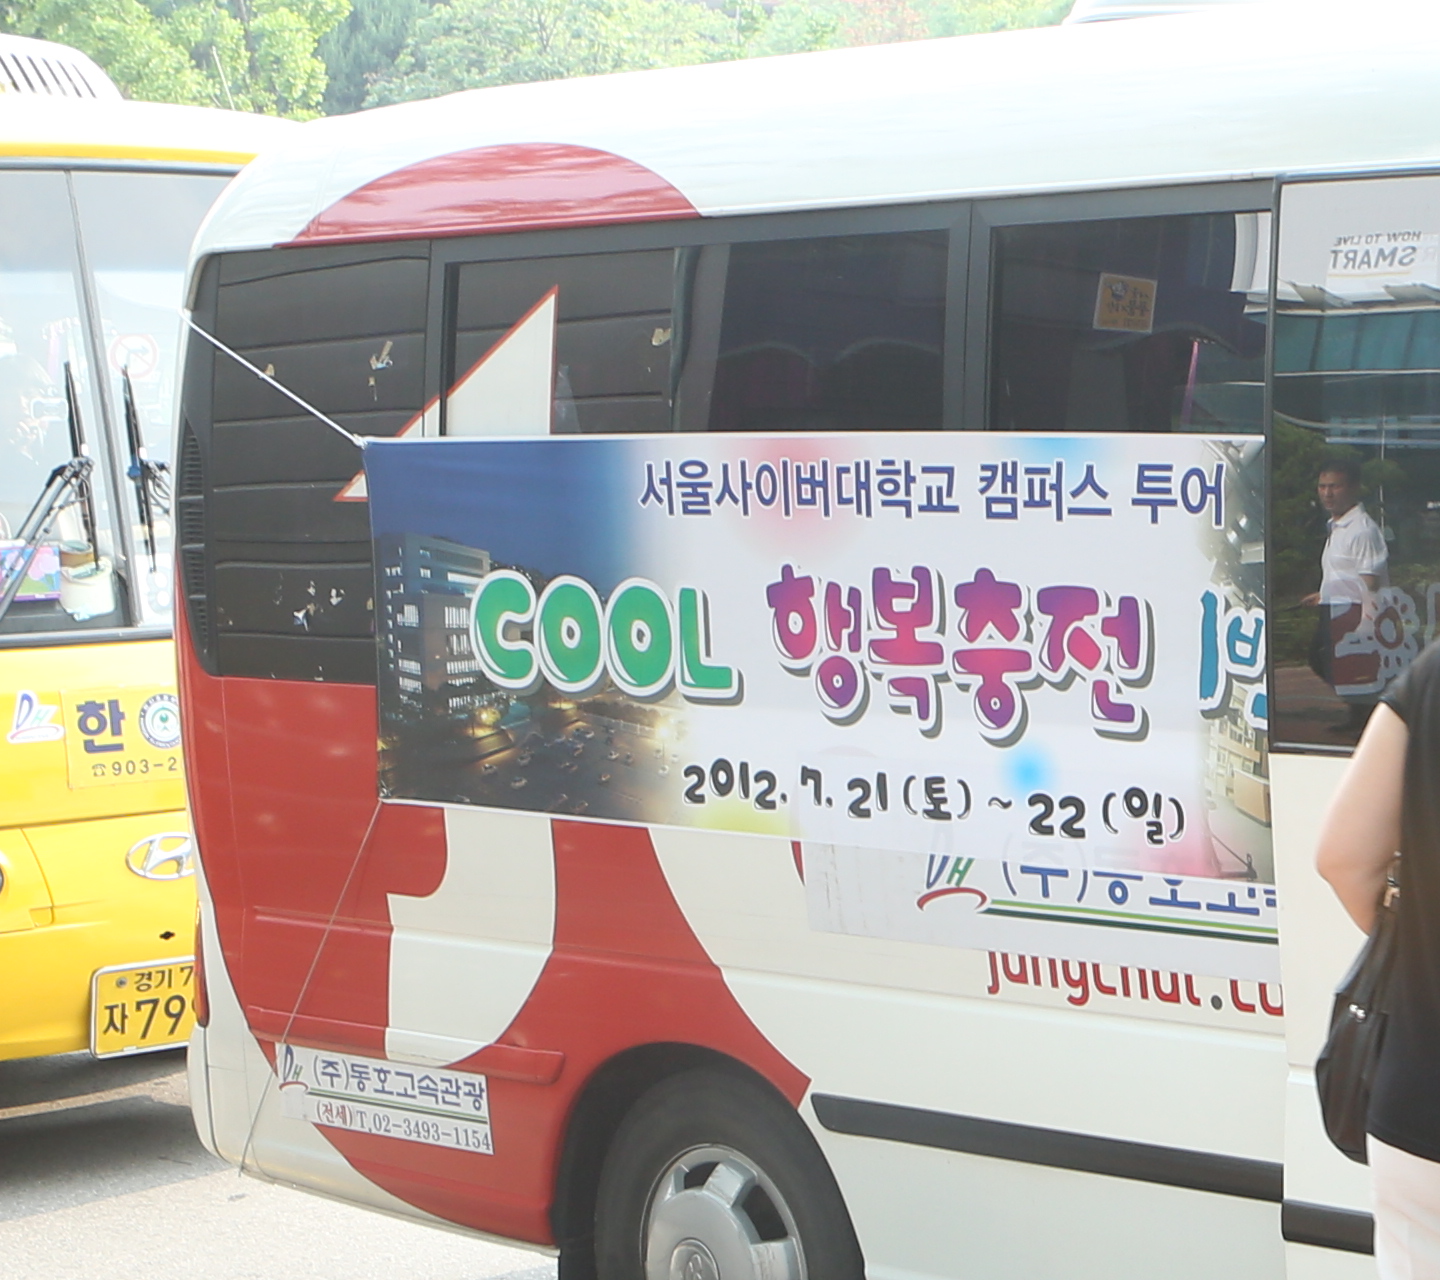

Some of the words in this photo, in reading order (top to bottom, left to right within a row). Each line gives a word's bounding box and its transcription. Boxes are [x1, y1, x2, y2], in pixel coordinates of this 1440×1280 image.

[639, 458, 961, 518] 서울사이버대학교
[978, 460, 1114, 523] 캠퍼스
[1130, 461, 1226, 527] 투어
[471, 572, 738, 696] COOL
[765, 562, 1142, 732] 행복충전
[76, 699, 126, 754] 한
[134, 968, 173, 992] 경기
[313, 1055, 486, 1112] (주)동호고속관광
